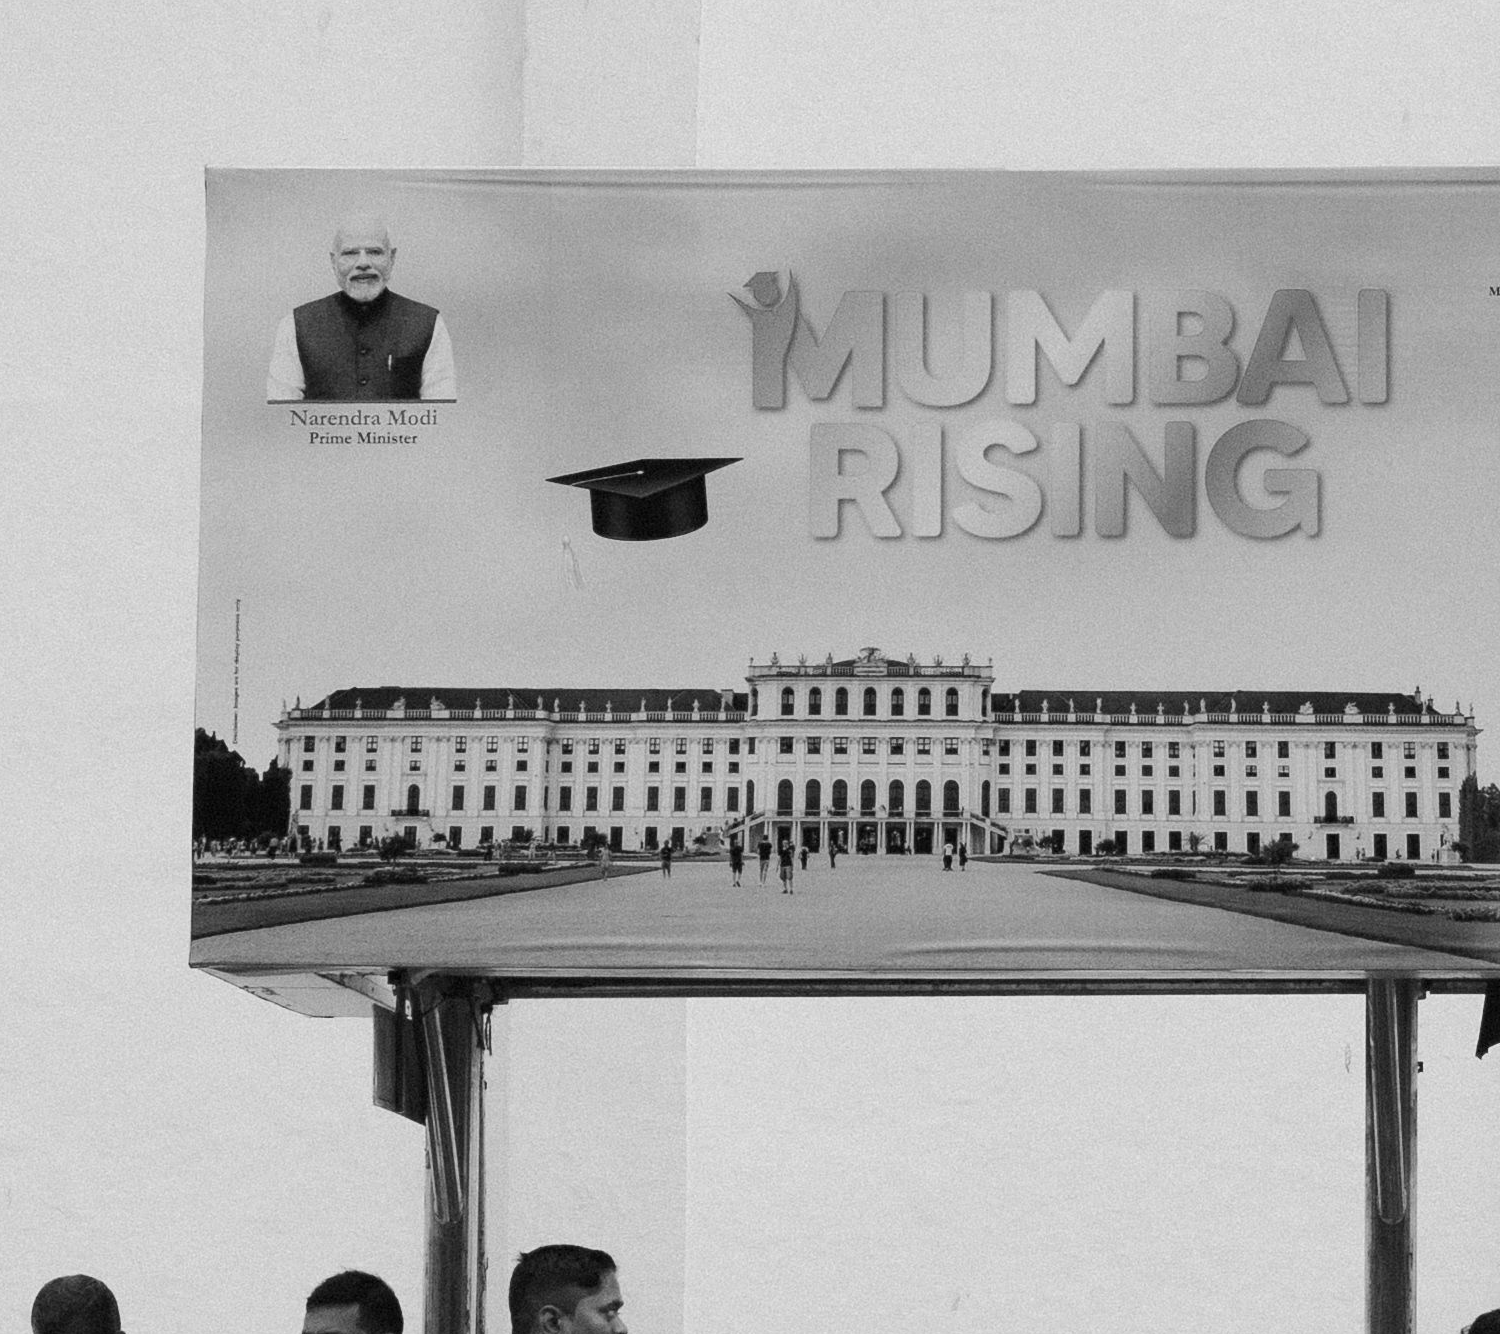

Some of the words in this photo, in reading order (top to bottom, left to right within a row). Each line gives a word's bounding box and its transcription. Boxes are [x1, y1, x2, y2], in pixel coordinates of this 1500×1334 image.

[728, 270, 1389, 409] MUMBAI
[289, 408, 381, 427] Narendra
[388, 409, 437, 426] Modi
[309, 431, 352, 445] Prime
[357, 431, 418, 445] Minister
[808, 419, 1322, 541] RISING
